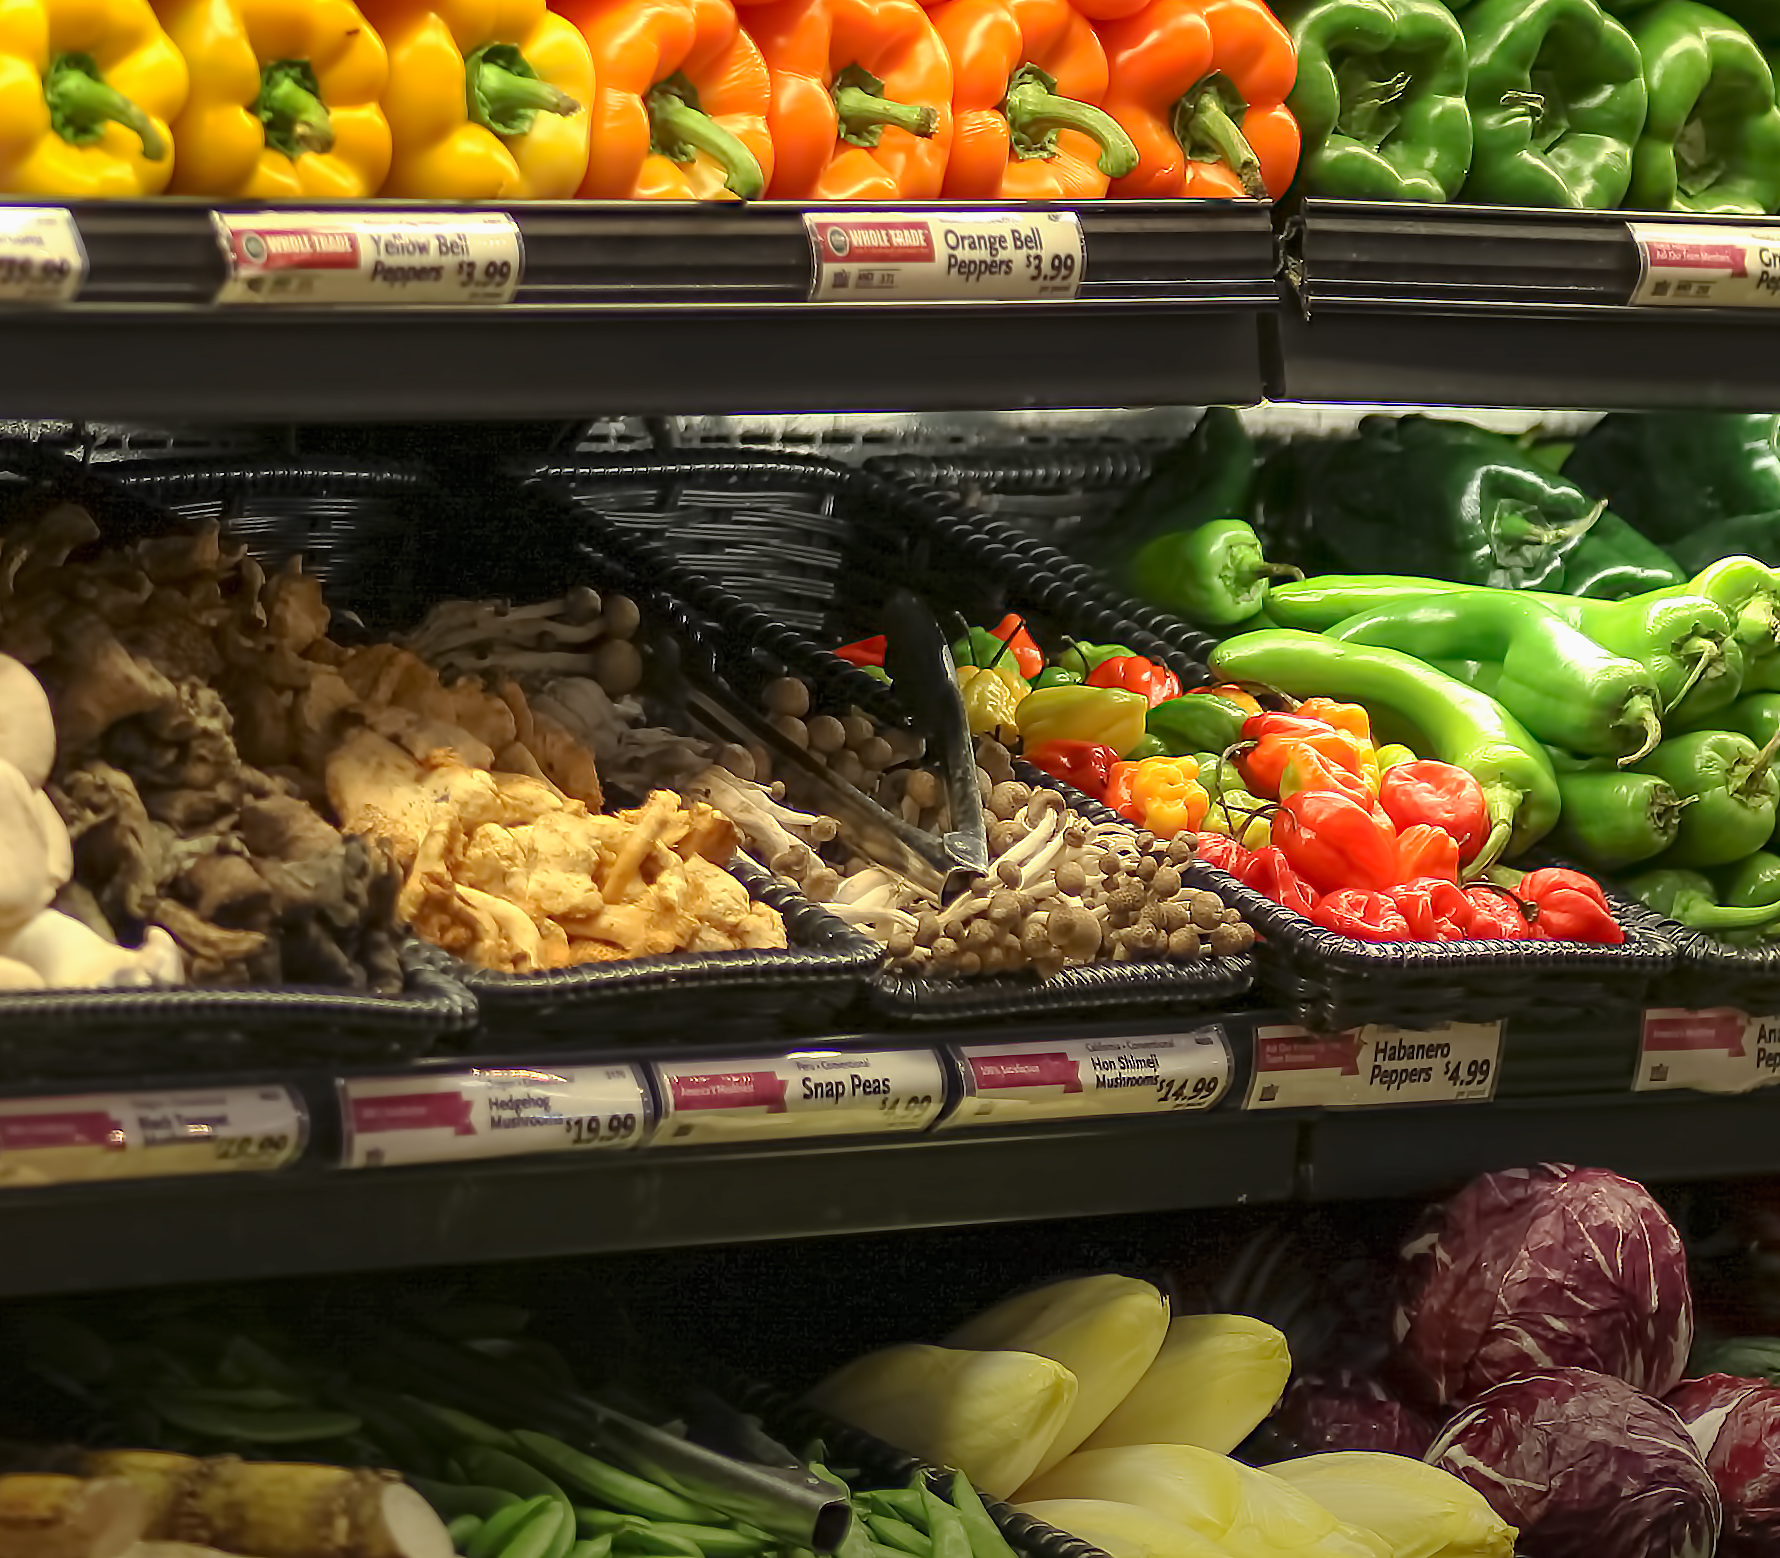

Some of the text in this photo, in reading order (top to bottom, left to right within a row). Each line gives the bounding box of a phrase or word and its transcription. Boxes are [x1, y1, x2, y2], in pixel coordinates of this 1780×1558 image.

[370, 233, 472, 257] Yellow Bell
[848, 229, 890, 248] WHOLE
[944, 226, 1044, 257] Orange Bell
[371, 260, 512, 289] Peppers $3.99
[947, 253, 1076, 283] Peppers $3.99
[1090, 1054, 1160, 1074] Hon Shimeji
[1374, 1038, 1451, 1062] Habanero
[802, 1073, 891, 1104] Snap Peas
[1095, 1073, 1219, 1103] Mushrooms $14.99
[1370, 1058, 1491, 1091] Peppers $4.99
[488, 1093, 551, 1117] Hedgehog
[490, 1112, 637, 1145] Mushrooms $19.99
